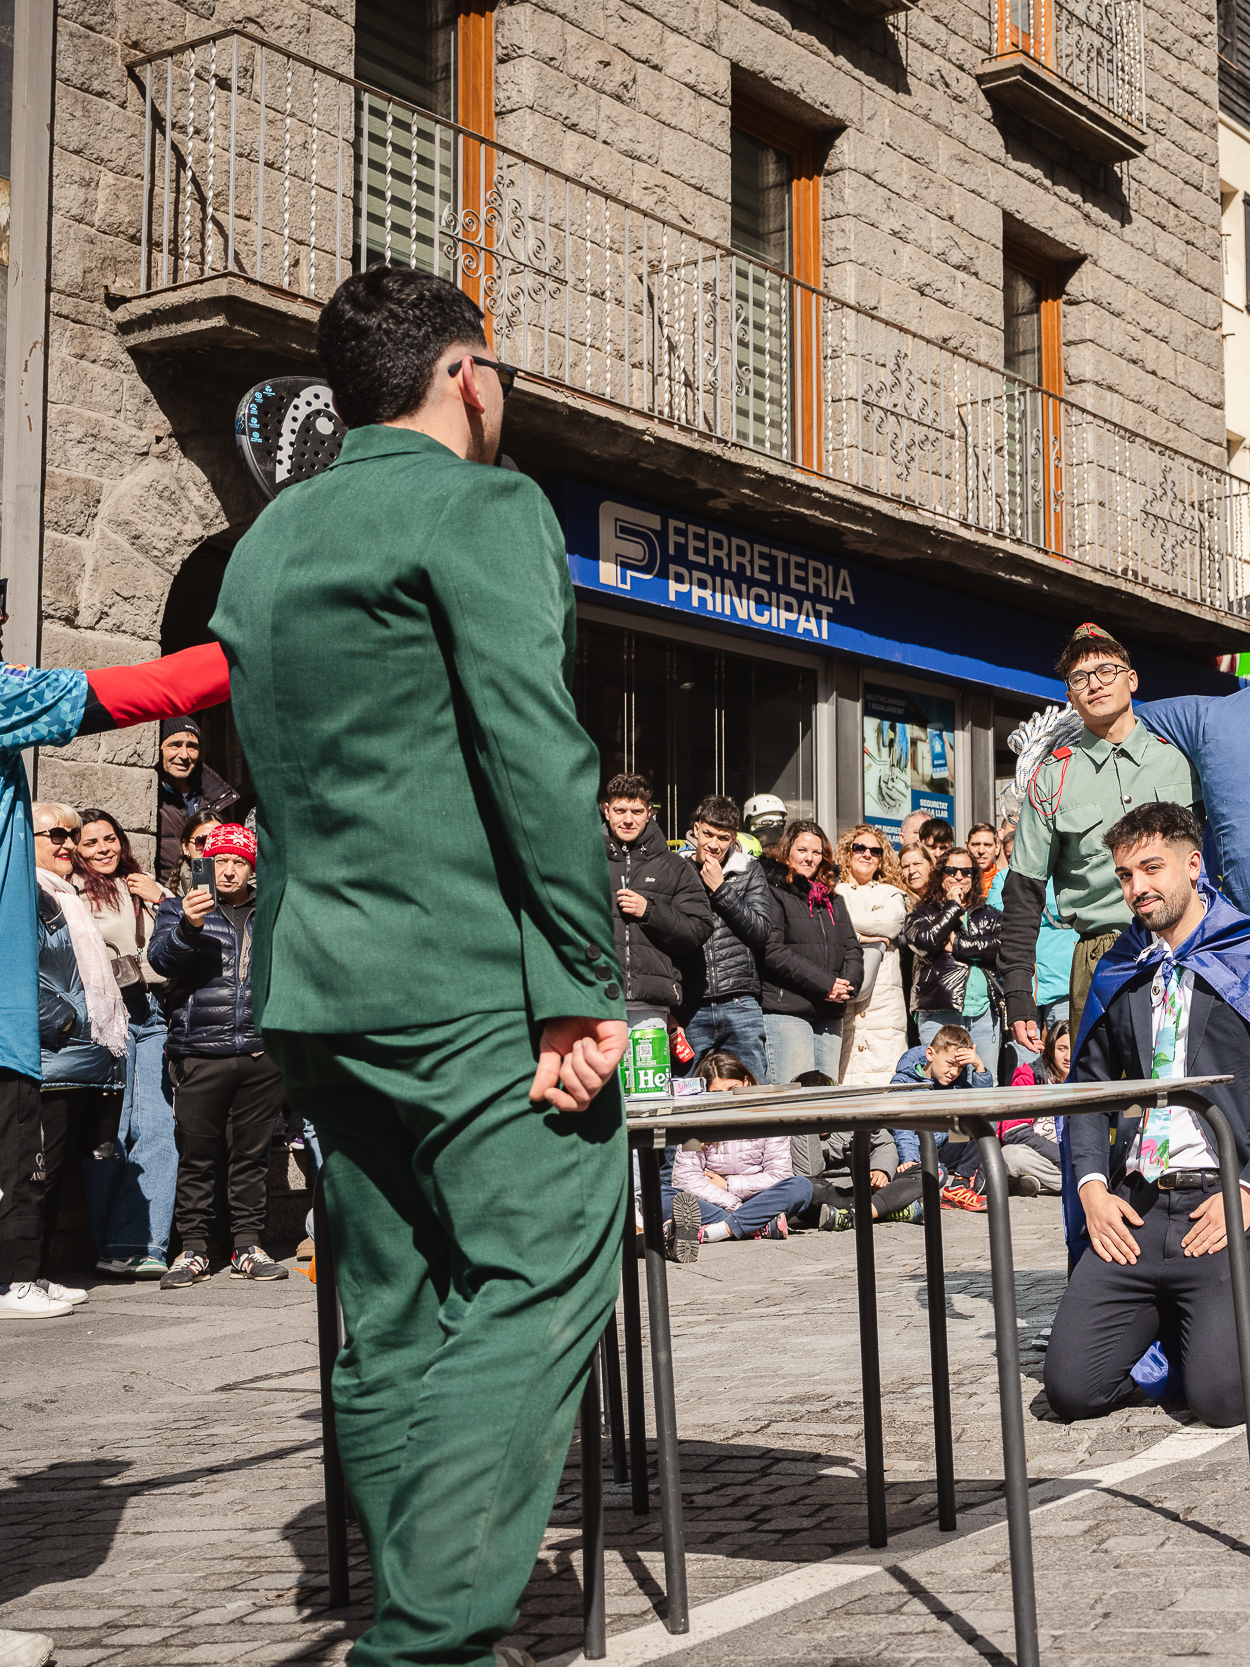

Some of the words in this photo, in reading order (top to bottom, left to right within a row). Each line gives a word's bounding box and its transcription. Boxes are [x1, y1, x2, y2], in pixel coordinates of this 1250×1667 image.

[668, 518, 855, 604] FERRETERIA
[668, 563, 833, 640] PRINCIPAT
[919, 798, 948, 810] SEGURETAT
[935, 809, 948, 819] LLAR
